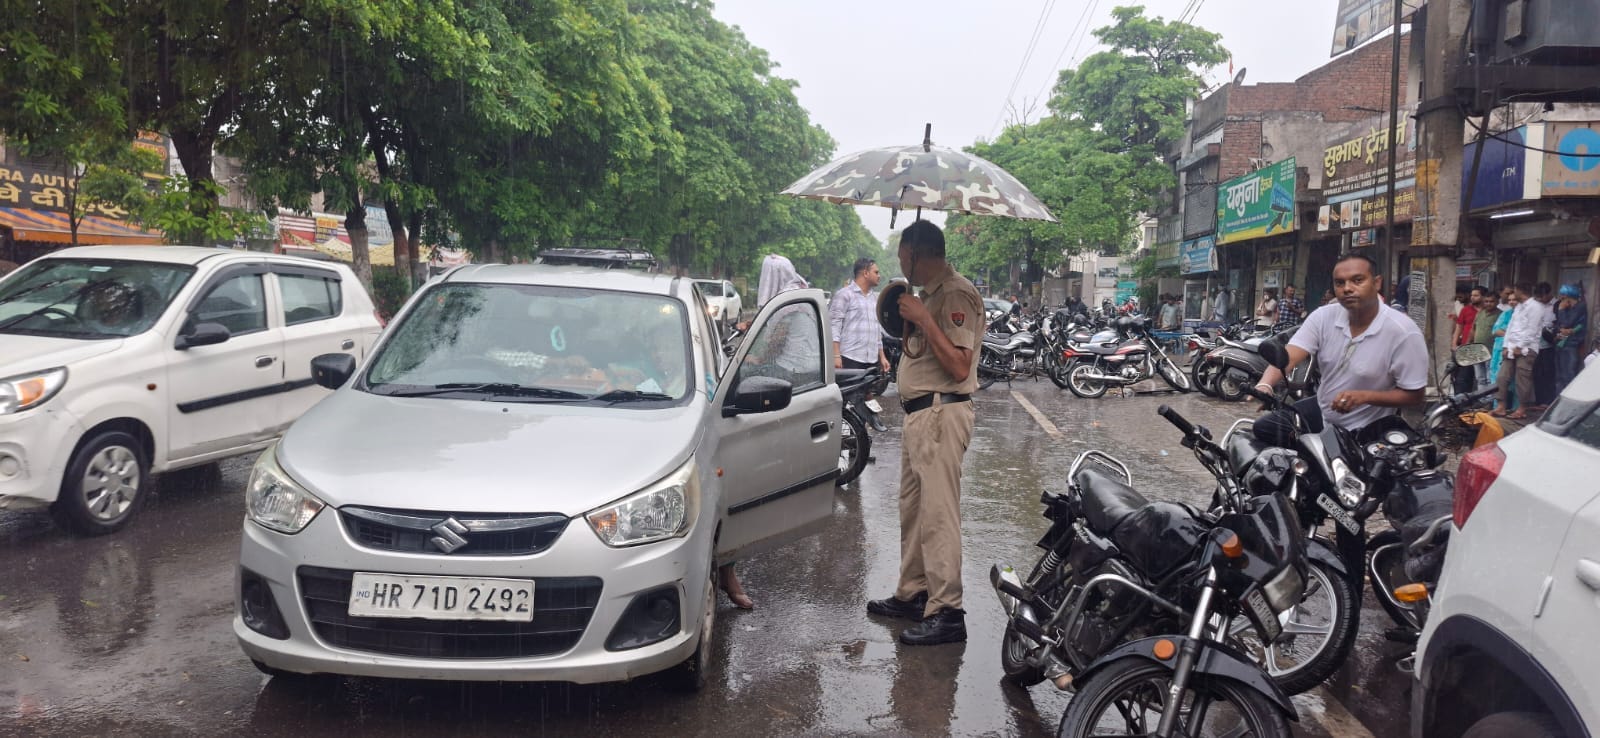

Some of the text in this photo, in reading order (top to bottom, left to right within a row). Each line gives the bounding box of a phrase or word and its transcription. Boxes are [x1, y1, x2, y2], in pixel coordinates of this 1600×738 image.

[1324, 136, 1363, 178] सुभाष
[1226, 176, 1261, 218] यमुना
[356, 590, 370, 599] IND
[372, 582, 529, 613] HR 71D 2492
